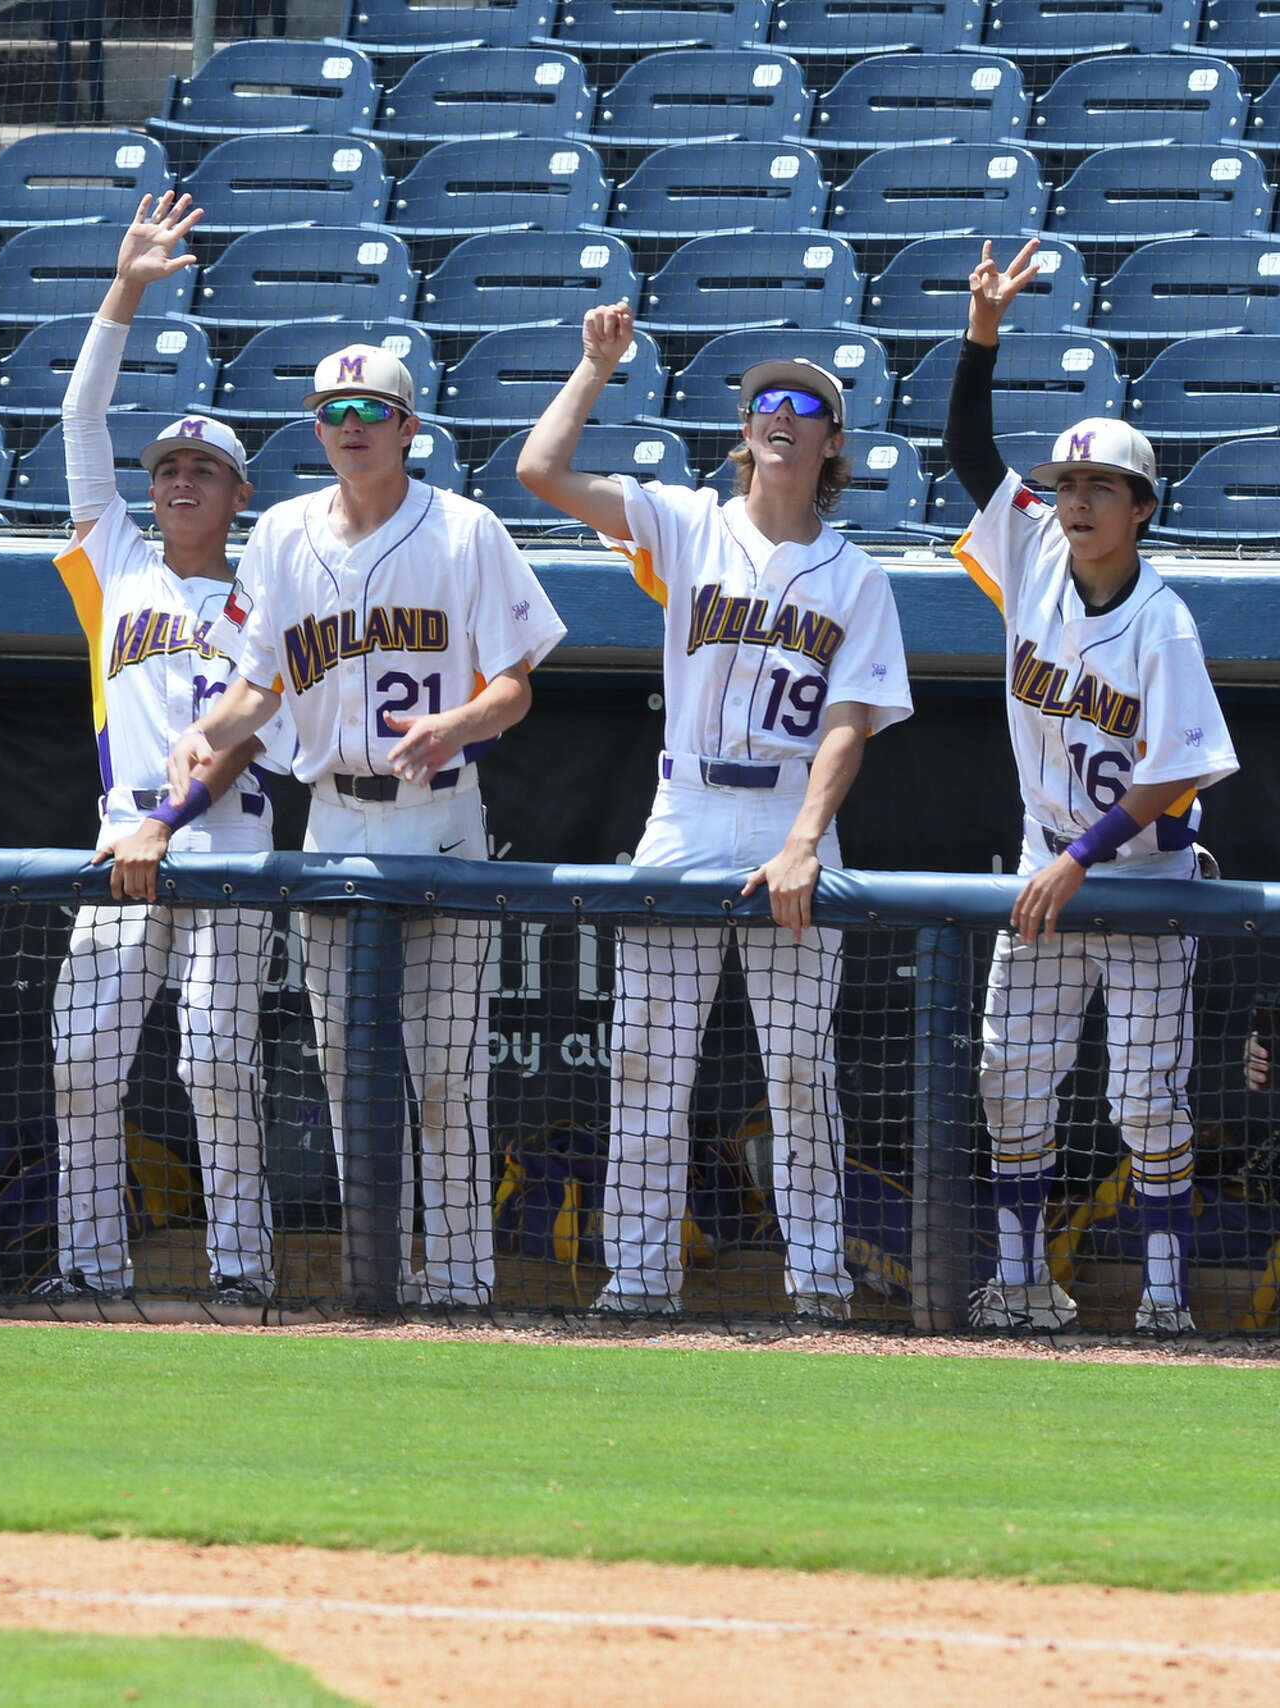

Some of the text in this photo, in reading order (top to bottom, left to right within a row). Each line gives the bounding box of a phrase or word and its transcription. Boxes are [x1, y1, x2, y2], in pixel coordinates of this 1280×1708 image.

[337, 355, 367, 384] M
[176, 419, 208, 439] M
[1066, 431, 1096, 462] M
[686, 583, 847, 666] MIDLAND
[376, 671, 441, 738] 21
[761, 667, 829, 738] 19
[1010, 633, 1142, 739] MIDLAND
[1069, 742, 1132, 813] 16
